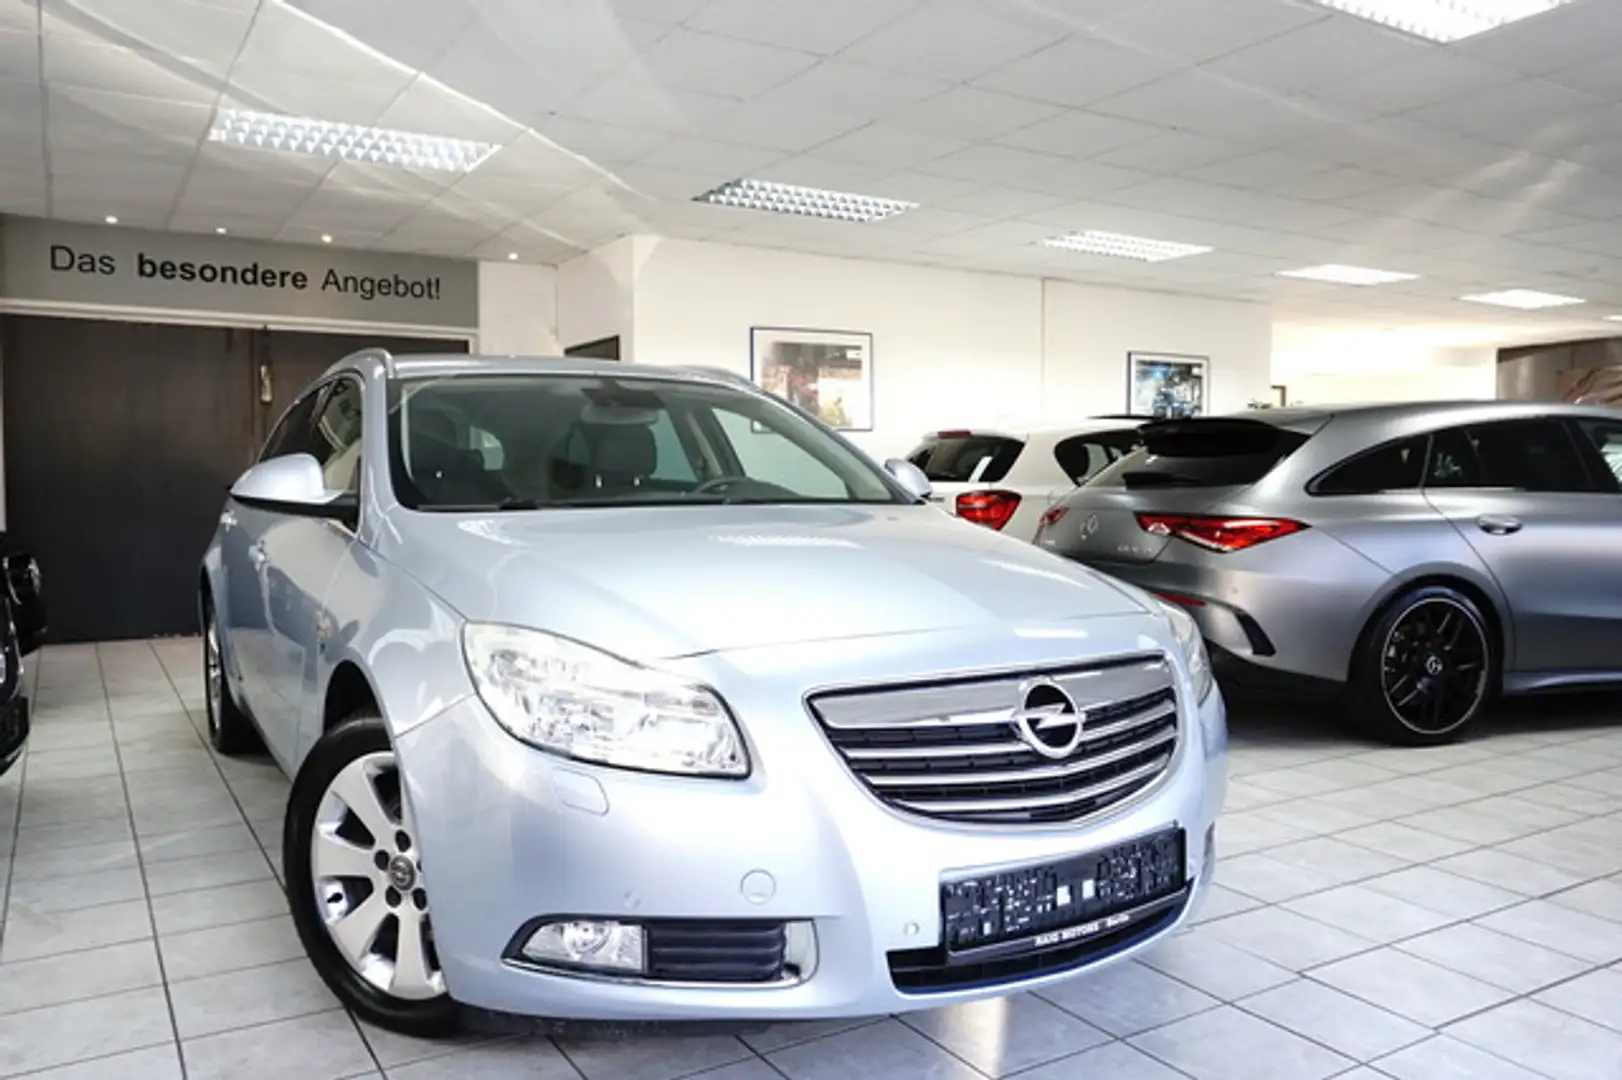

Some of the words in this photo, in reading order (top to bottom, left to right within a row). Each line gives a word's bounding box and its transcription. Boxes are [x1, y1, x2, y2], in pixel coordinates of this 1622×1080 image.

[49, 244, 116, 276] Das
[137, 252, 308, 290] besondere
[321, 268, 441, 301] Angebot!
